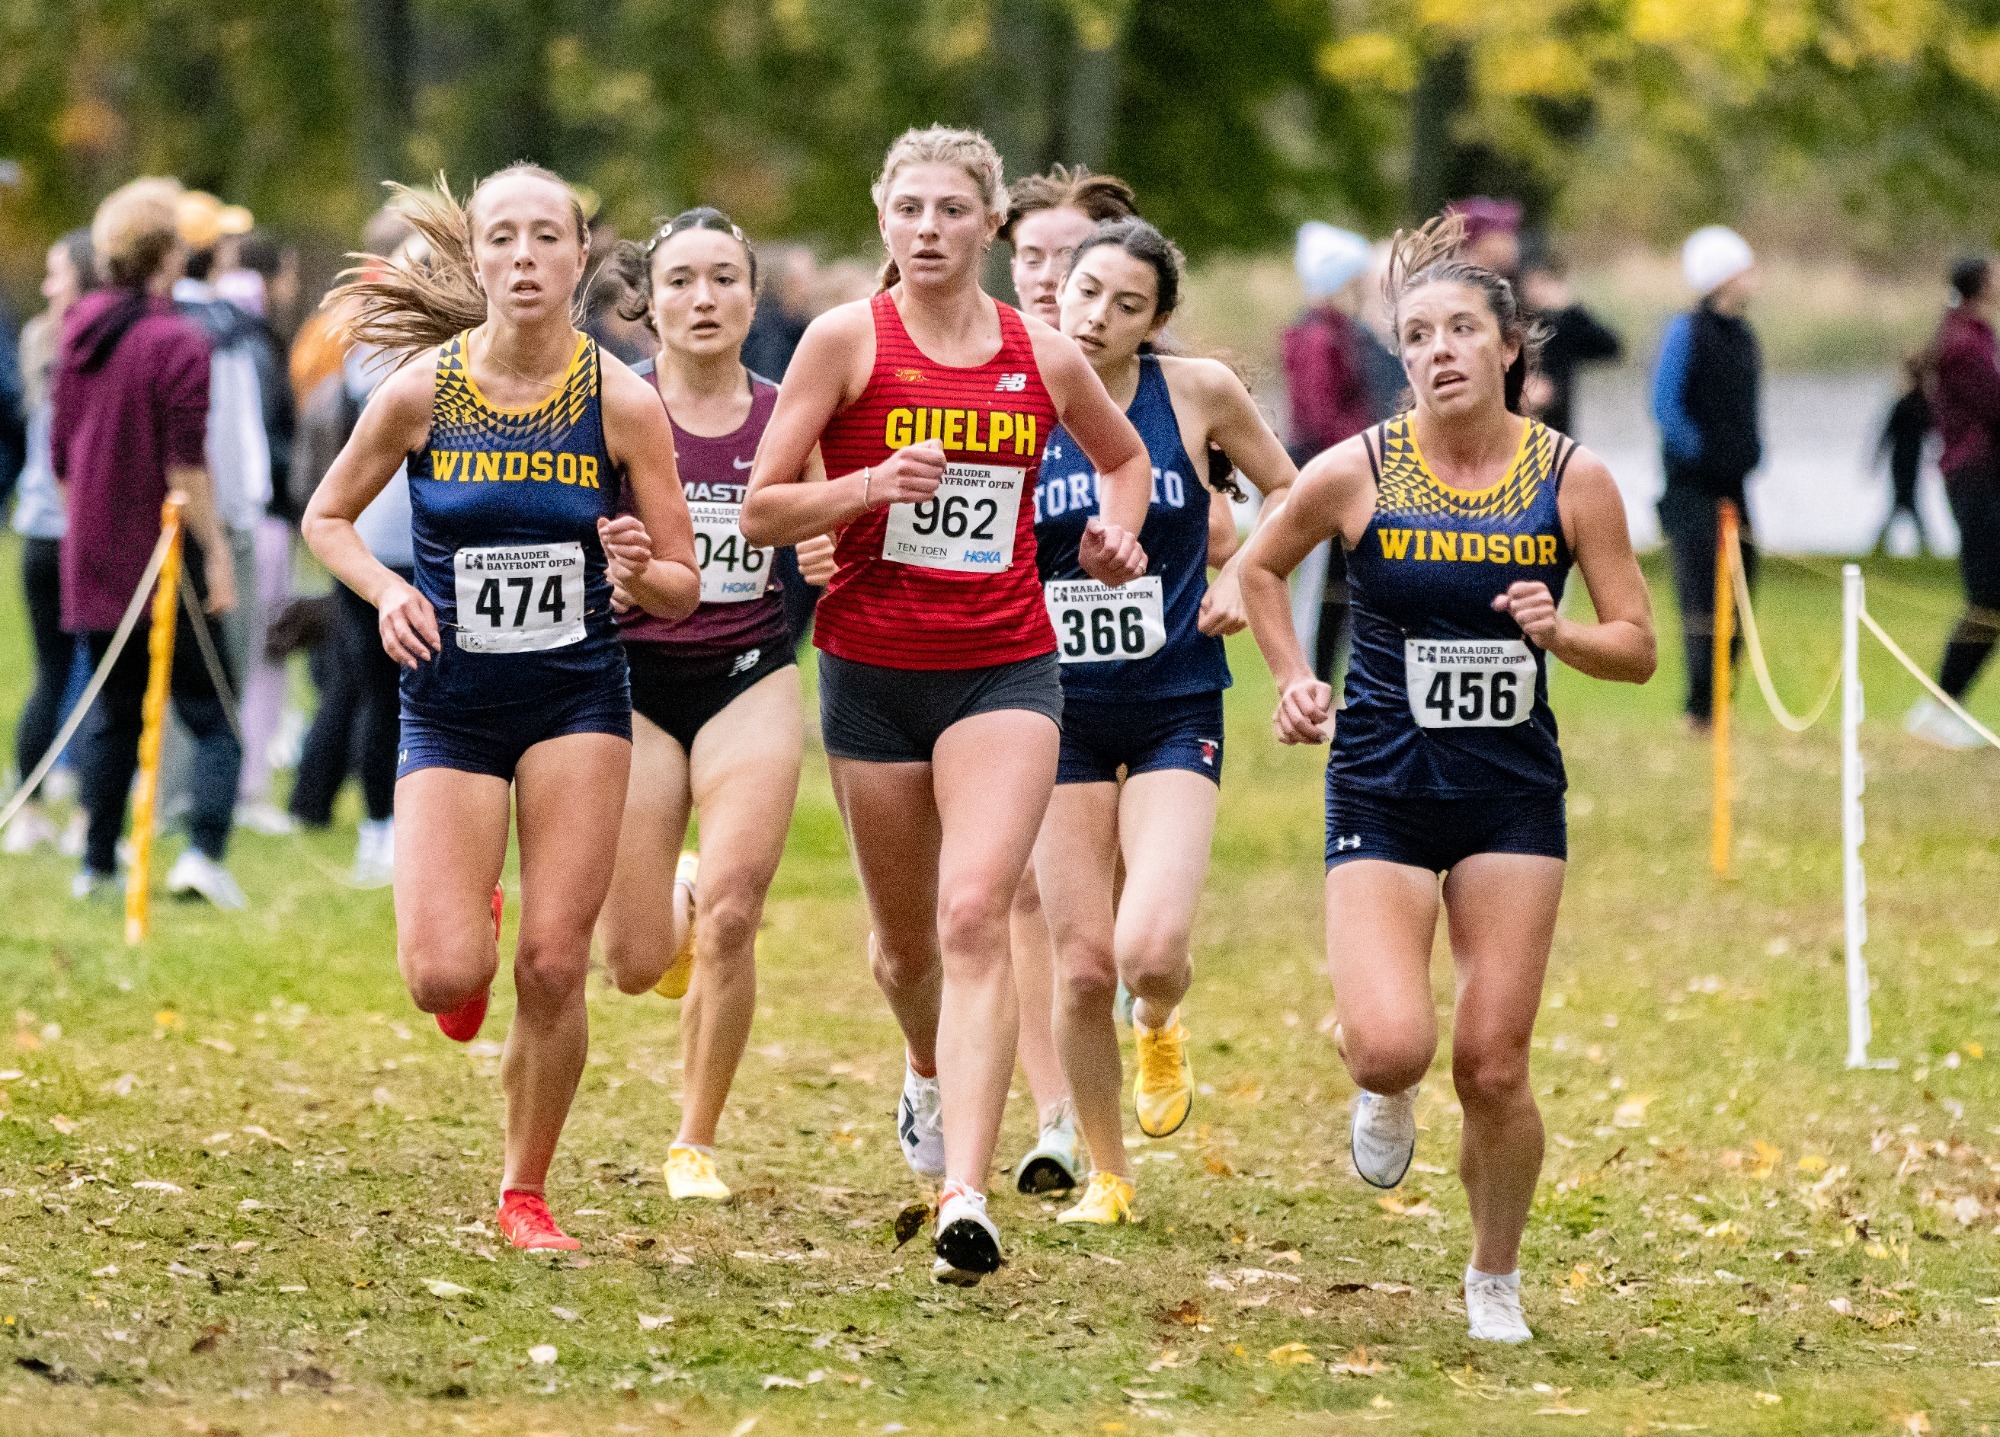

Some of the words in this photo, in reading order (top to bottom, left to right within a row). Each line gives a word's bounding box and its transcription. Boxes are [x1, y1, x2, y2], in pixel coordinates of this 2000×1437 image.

[885, 408, 1037, 456] GUELPH
[431, 450, 600, 488] WINDSOR
[943, 468, 991, 478] ARAUDER
[938, 477, 986, 488] AYFRONT
[988, 480, 1015, 490] OPEN
[683, 482, 747, 501] MAST
[1032, 467, 1185, 524] TORTO
[693, 516, 739, 525] AYFRONT
[912, 495, 998, 541] 962
[898, 542, 917, 552] TEN
[1378, 528, 1558, 566] WINDSOR
[486, 551, 550, 561] MARAUDER
[963, 550, 1002, 564] HOKA
[486, 561, 546, 571] BAYFRONT
[548, 558, 576, 568] OPEN
[721, 582, 757, 593] HOKA
[475, 574, 566, 628] 474
[1070, 592, 1124, 602] BAYFRONT
[1127, 591, 1154, 600] OPEN
[1062, 606, 1145, 657] 366
[1439, 646, 1504, 655] MARAUDER
[1439, 656, 1499, 665] BAYFRONT
[1502, 655, 1527, 665] OPEN
[1425, 671, 1518, 721] 456
